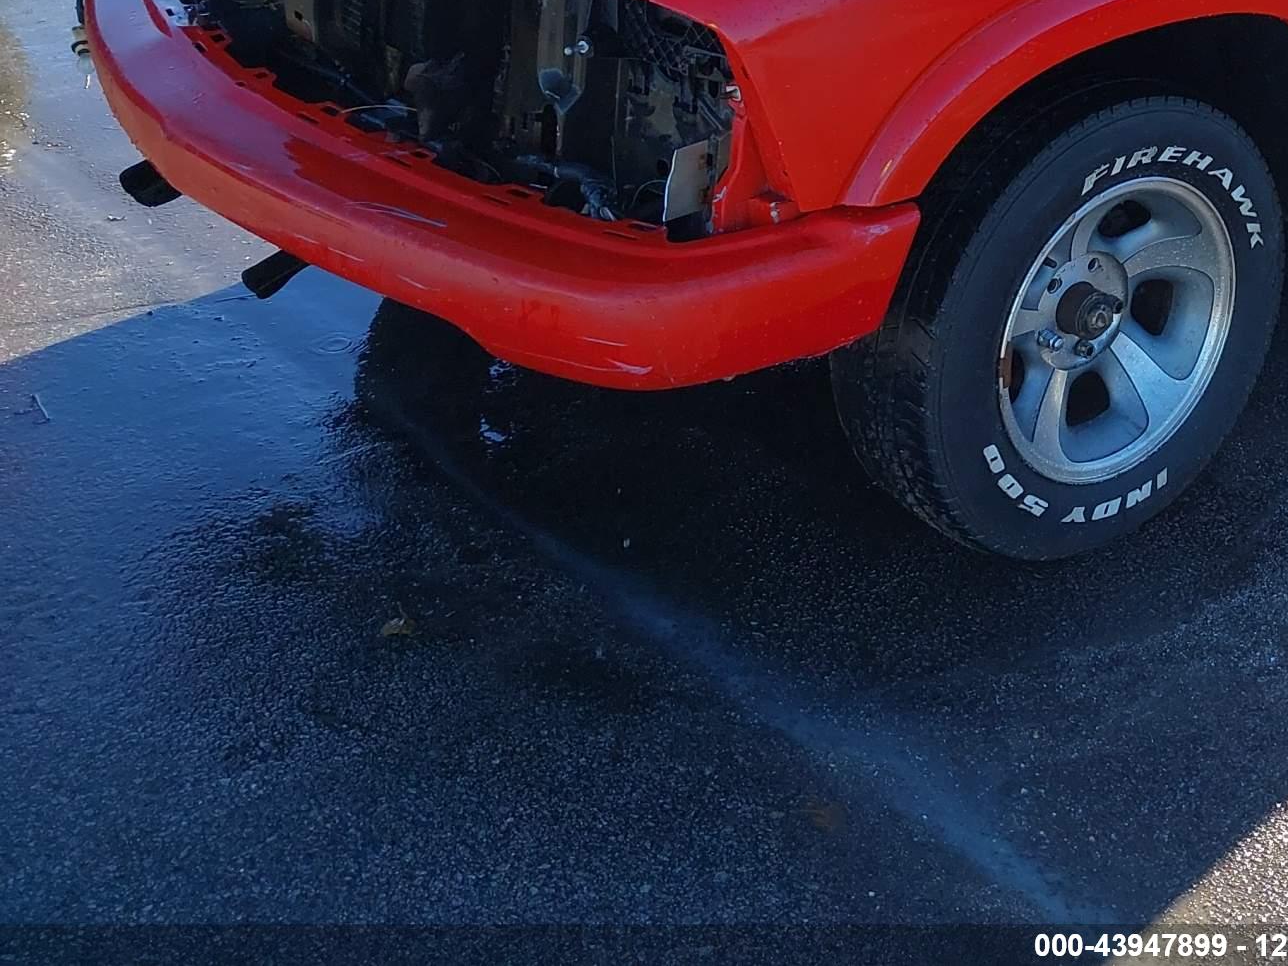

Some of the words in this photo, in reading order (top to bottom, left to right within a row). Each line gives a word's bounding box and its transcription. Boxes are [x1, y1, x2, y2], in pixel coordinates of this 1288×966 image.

[1080, 144, 1265, 250] FIREHAWK
[982, 442, 1050, 519] 500
[1061, 465, 1169, 524] INDY
